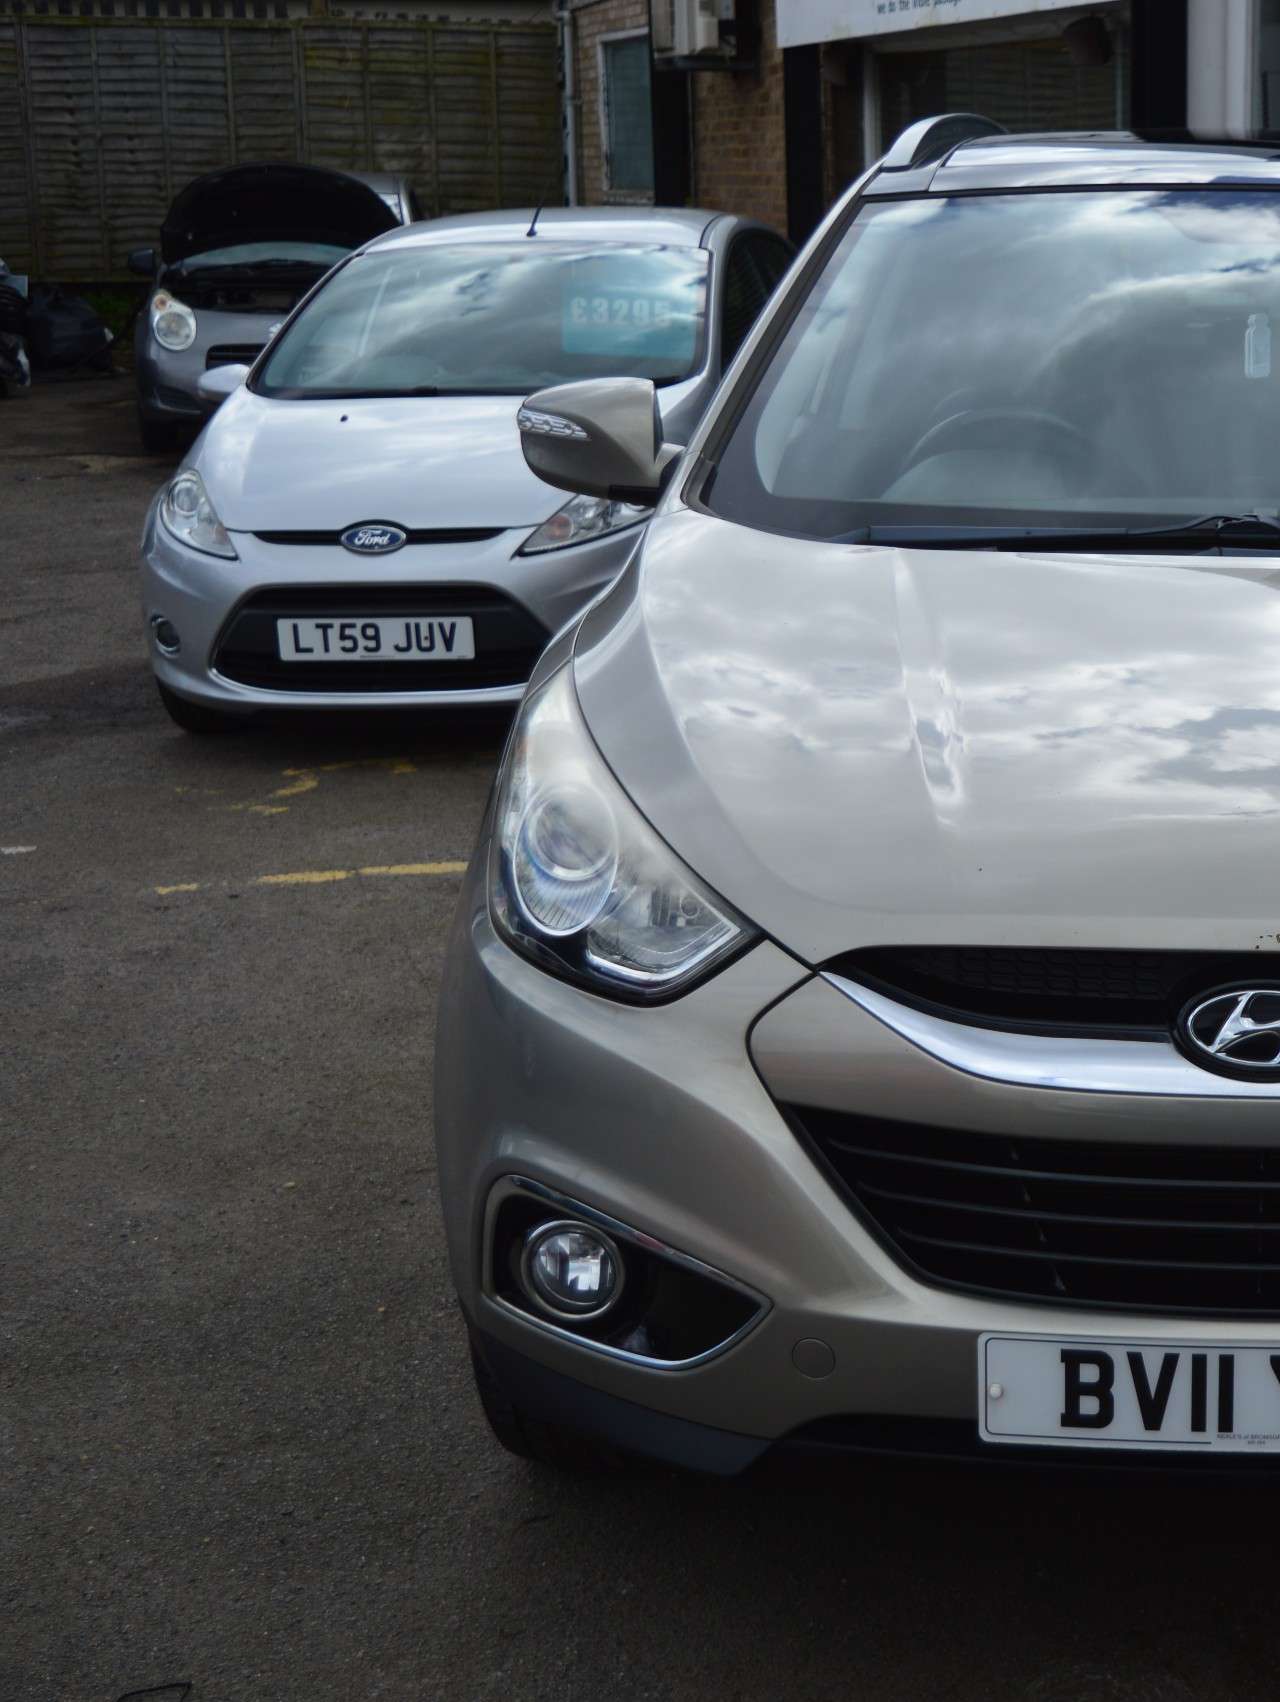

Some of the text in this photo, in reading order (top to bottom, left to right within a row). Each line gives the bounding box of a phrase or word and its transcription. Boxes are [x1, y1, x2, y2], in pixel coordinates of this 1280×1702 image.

[571, 297, 672, 327] £3295
[353, 529, 391, 547] Ford
[292, 621, 457, 654] LT59 JUV
[1060, 1348, 1235, 1433] BV11
